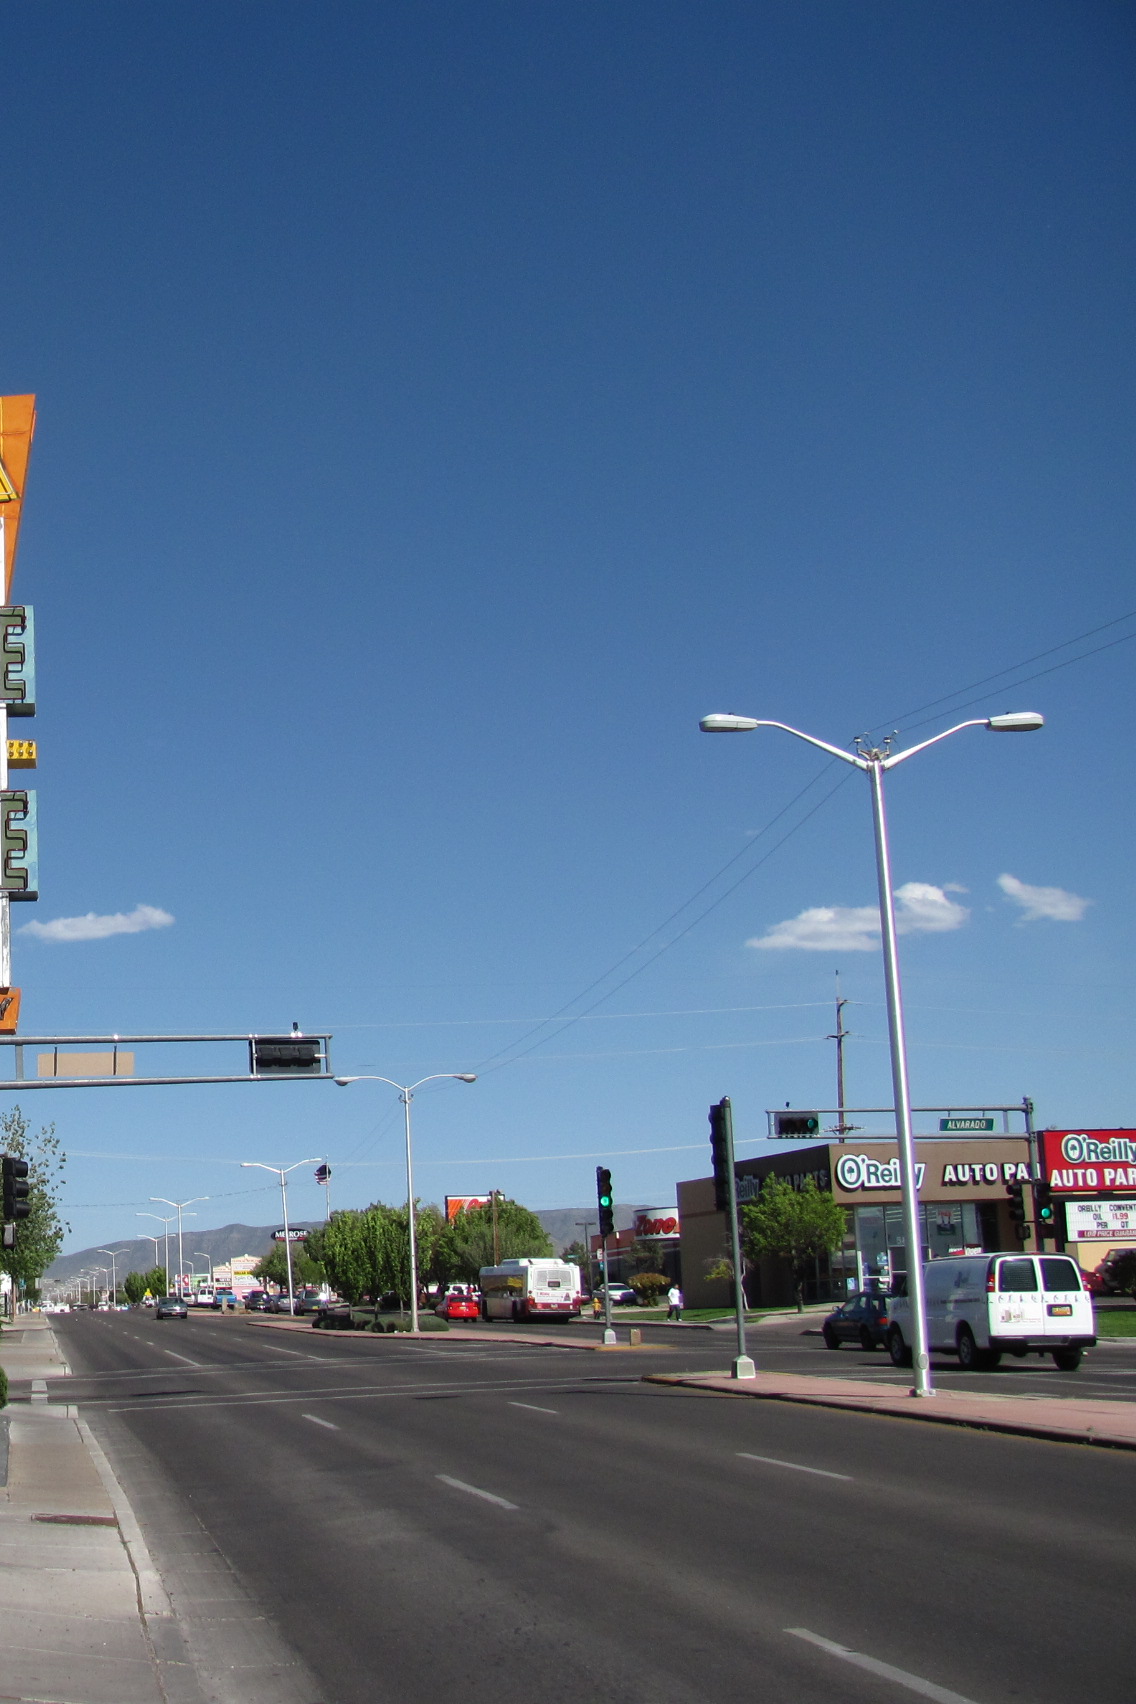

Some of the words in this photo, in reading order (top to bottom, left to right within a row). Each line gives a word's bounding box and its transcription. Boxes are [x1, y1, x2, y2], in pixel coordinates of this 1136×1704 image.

[947, 1119, 986, 1130] ALVARADO
[1061, 1134, 1136, 1165] O'Reilly
[837, 1154, 926, 1189] O'Reiy
[944, 1163, 998, 1183] AUTO
[1049, 1168, 1098, 1188] AUTO
[1096, 1221, 1108, 1229] PER
[274, 1230, 308, 1238] MEROSE
